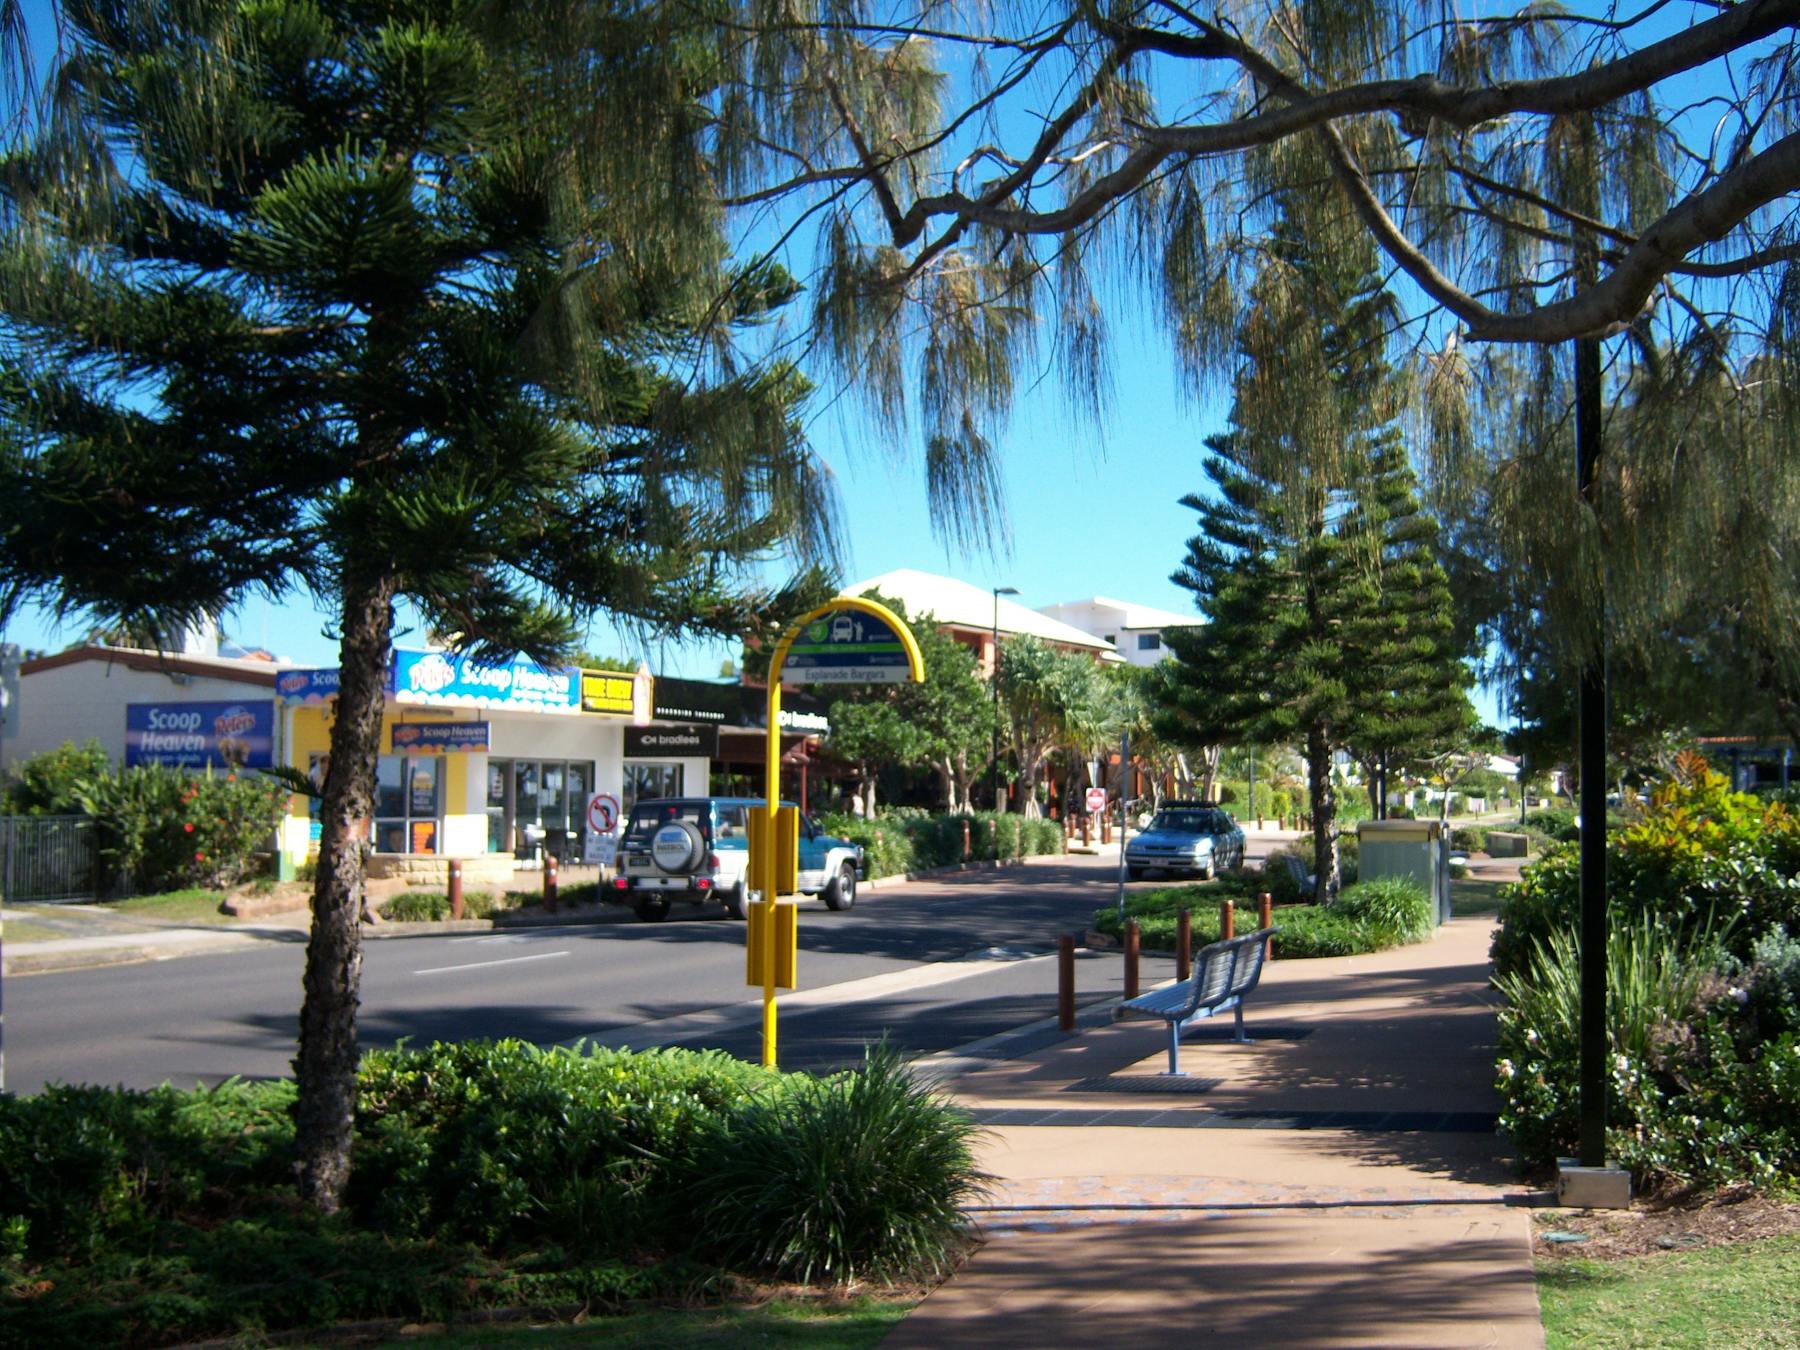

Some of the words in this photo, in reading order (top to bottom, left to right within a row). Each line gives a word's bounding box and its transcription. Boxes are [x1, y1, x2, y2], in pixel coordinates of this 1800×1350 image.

[312, 672, 340, 686] Scoo
[460, 659, 512, 692] Scoop
[512, 666, 569, 692] Heaven
[805, 669, 848, 680] Esplanade
[850, 669, 886, 680] Bargara
[148, 708, 202, 733] Scoop
[423, 726, 450, 738] Scoop
[450, 726, 486, 736] Heaven
[140, 731, 206, 751] Heaven
[659, 735, 700, 745] bradlees
